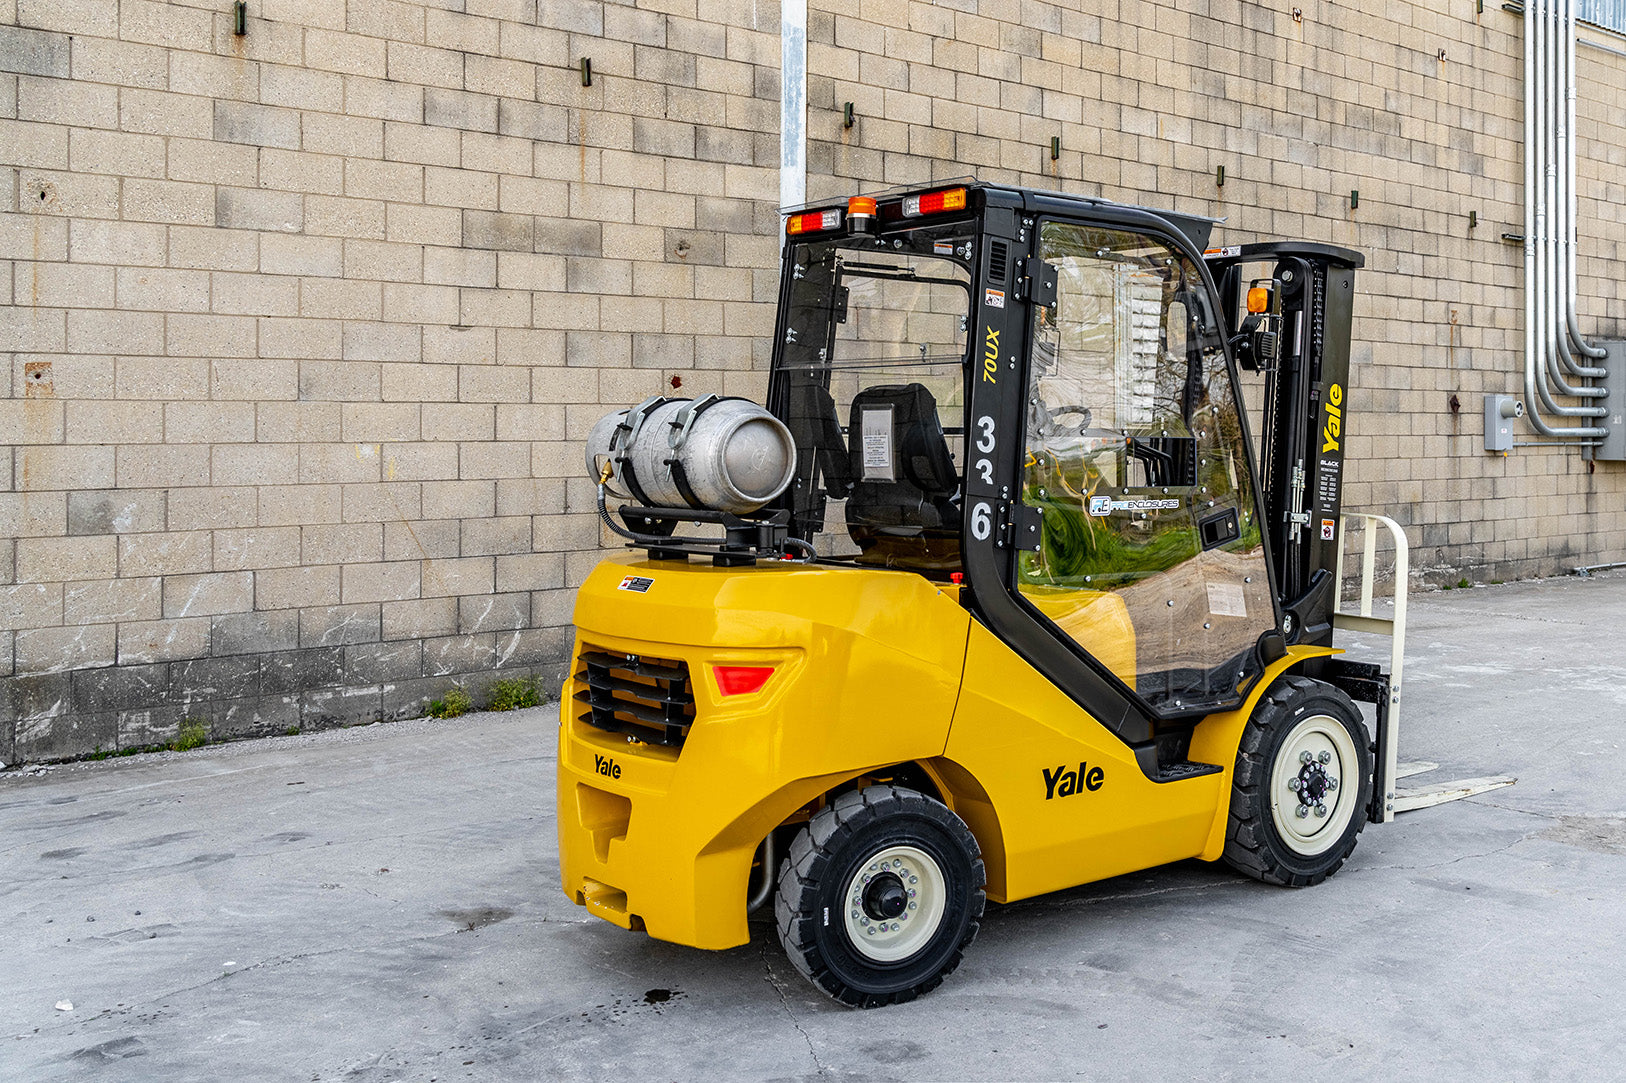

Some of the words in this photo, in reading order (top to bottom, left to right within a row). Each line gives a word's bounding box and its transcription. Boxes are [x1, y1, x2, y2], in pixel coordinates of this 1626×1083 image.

[983, 325, 1000, 385] 70UX
[1322, 383, 1343, 454] Yale
[594, 753, 622, 779] Yale
[1042, 761, 1104, 800] Yale
